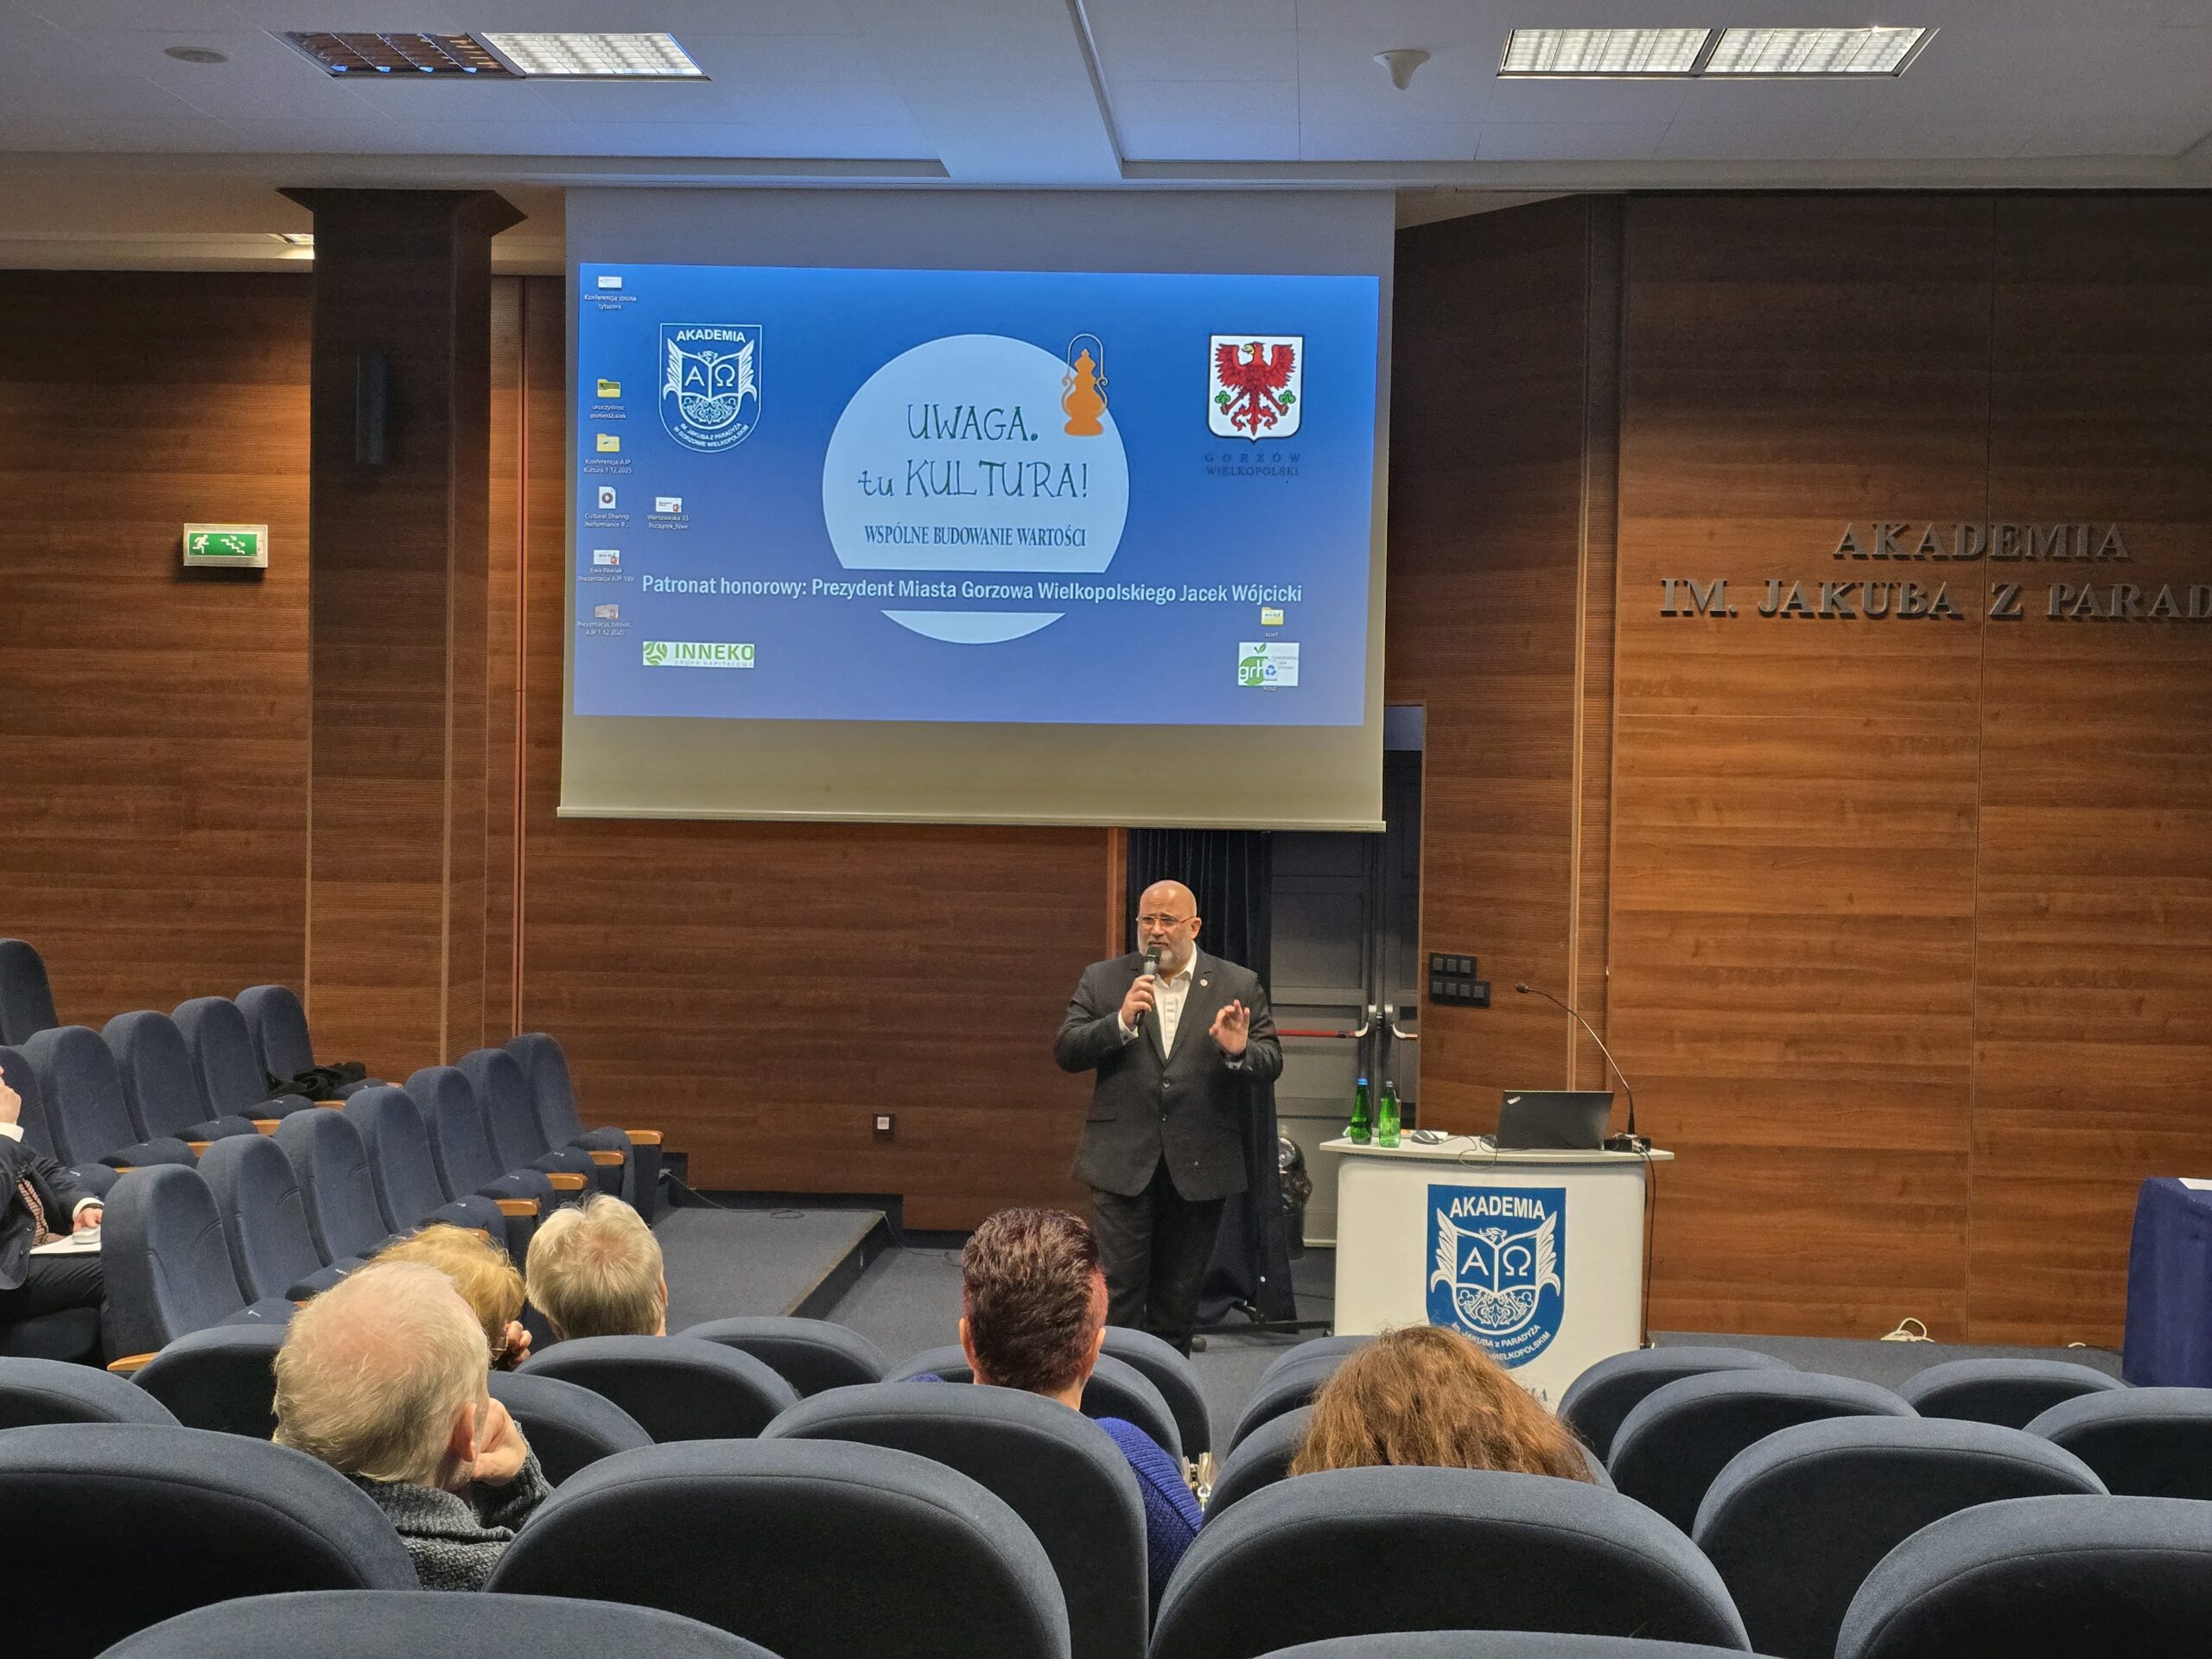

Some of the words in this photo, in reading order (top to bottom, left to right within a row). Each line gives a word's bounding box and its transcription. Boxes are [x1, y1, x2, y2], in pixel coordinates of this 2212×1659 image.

[677, 329, 746, 343] AKADEMIA
[907, 404, 1038, 442] UWAGA.
[678, 431, 706, 447] GORZOWIE
[858, 470, 894, 497] tu
[906, 459, 1089, 499] KULTURA!
[1206, 467, 1299, 476] WIELKOPOLSKI
[864, 522, 930, 544] WSPÓLNE
[933, 527, 1014, 546] BUDOWANIE
[1018, 524, 1087, 546] WARTOŚCI
[1833, 522, 2130, 559] AKADEMIA
[642, 575, 716, 594] Patronat
[721, 577, 807, 599] honorowy:
[811, 578, 894, 600] Prezydent
[899, 580, 956, 597] Miasta
[962, 582, 1033, 600] Gorzowa
[1038, 582, 1176, 605] Wielkopolskiego
[1179, 585, 1228, 602] Jacek
[1232, 584, 1303, 606] Wójcicki
[1661, 577, 1737, 615] IM.
[1758, 580, 1961, 617] JAKUBA
[1989, 582, 2022, 617] Z
[675, 643, 754, 660] INNEKO
[1449, 1196, 1547, 1220] AKADEMIA
